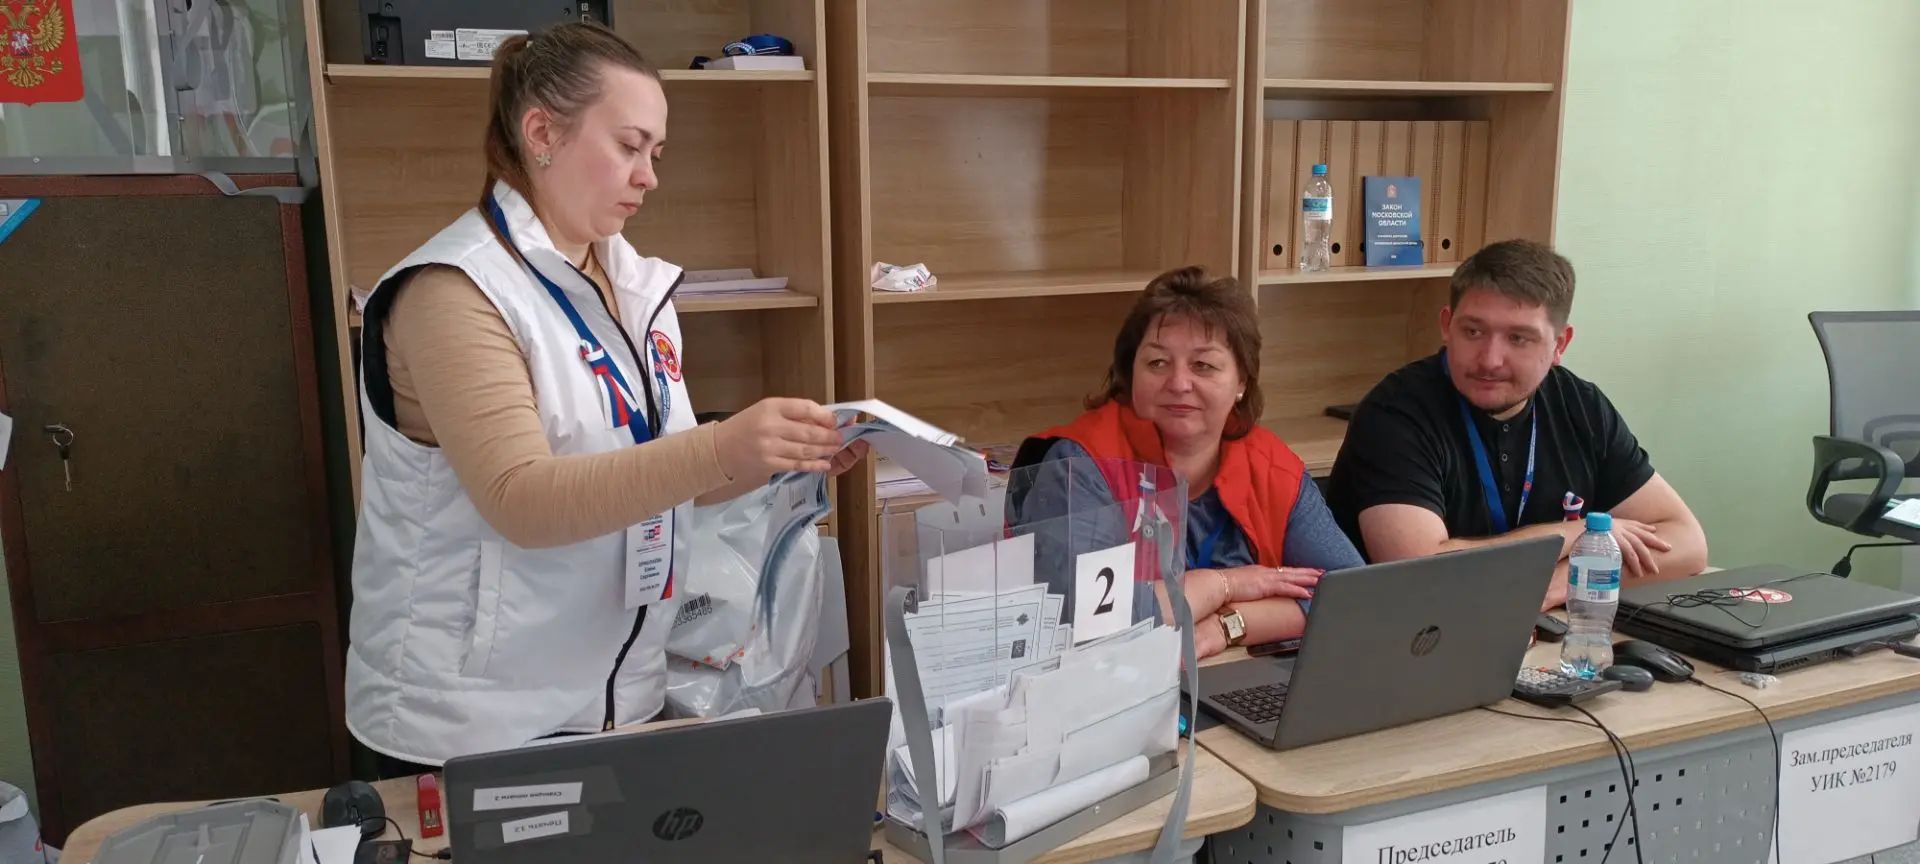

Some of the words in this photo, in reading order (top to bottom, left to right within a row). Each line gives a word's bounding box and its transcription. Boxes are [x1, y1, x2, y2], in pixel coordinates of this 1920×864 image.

[1371, 211, 1413, 219] МОСКОВСКОЙ
[1093, 566, 1115, 616] 2
[1790, 733, 1913, 768] Зам.председателя
[1811, 771, 1847, 792] УИК
[1849, 760, 1897, 786] №2179
[1378, 827, 1516, 864] Председатель
